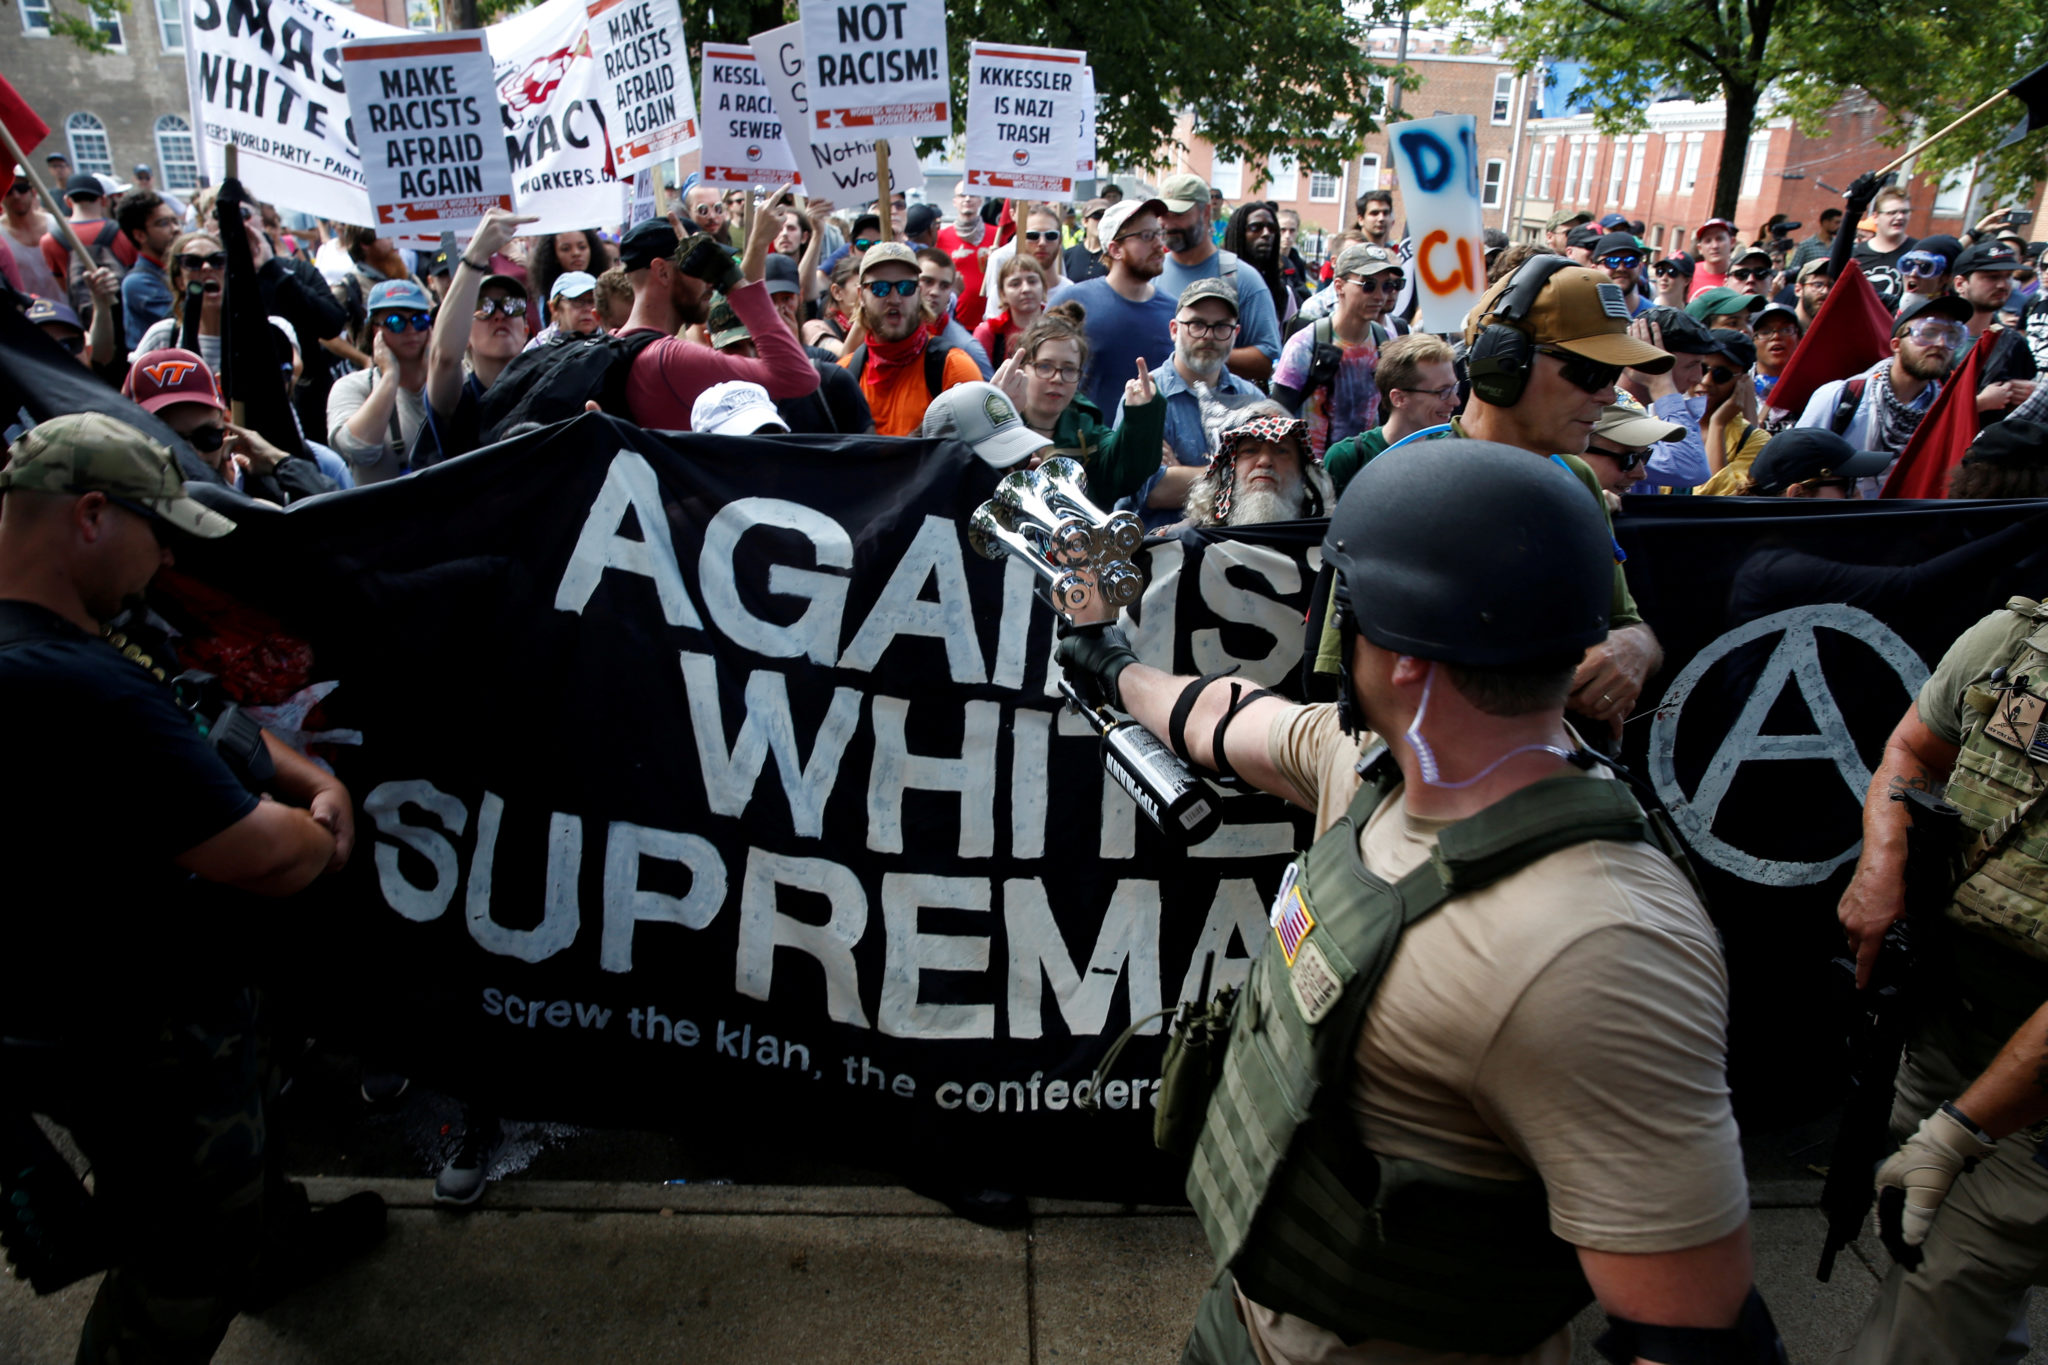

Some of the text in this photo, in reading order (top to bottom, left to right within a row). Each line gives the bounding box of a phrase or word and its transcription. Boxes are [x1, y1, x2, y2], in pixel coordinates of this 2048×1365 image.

[608, 2, 655, 45] MAKE
[837, 2, 907, 43] NOT
[604, 28, 671, 80] RACISTS
[818, 47, 939, 87] RACISM!
[380, 65, 457, 99] MAKE
[616, 63, 674, 111] AFRAID
[980, 66, 1072, 92] KKKESSLER
[368, 96, 481, 133] RACISTS
[625, 94, 676, 138] AGAIN
[719, 93, 777, 115] A RACI
[994, 96, 1054, 118] IS NAZI
[230, 128, 270, 153] WORLD
[272, 140, 311, 165] PARTY
[729, 119, 782, 140] SEWER
[997, 123, 1051, 144] TRASH
[387, 133, 484, 169] AFRAID
[400, 165, 483, 199] AGAIN
[832, 167, 895, 191] Wrog
[142, 361, 198, 388] VT
[554, 448, 1323, 698] AGAINS
[680, 650, 1296, 859] WHIT
[1106, 751, 1161, 825] TIPPMANN
[482, 987, 612, 1029] screw
[627, 1006, 700, 1047] the
[716, 1019, 822, 1080] klan,
[843, 1055, 917, 1098] the
